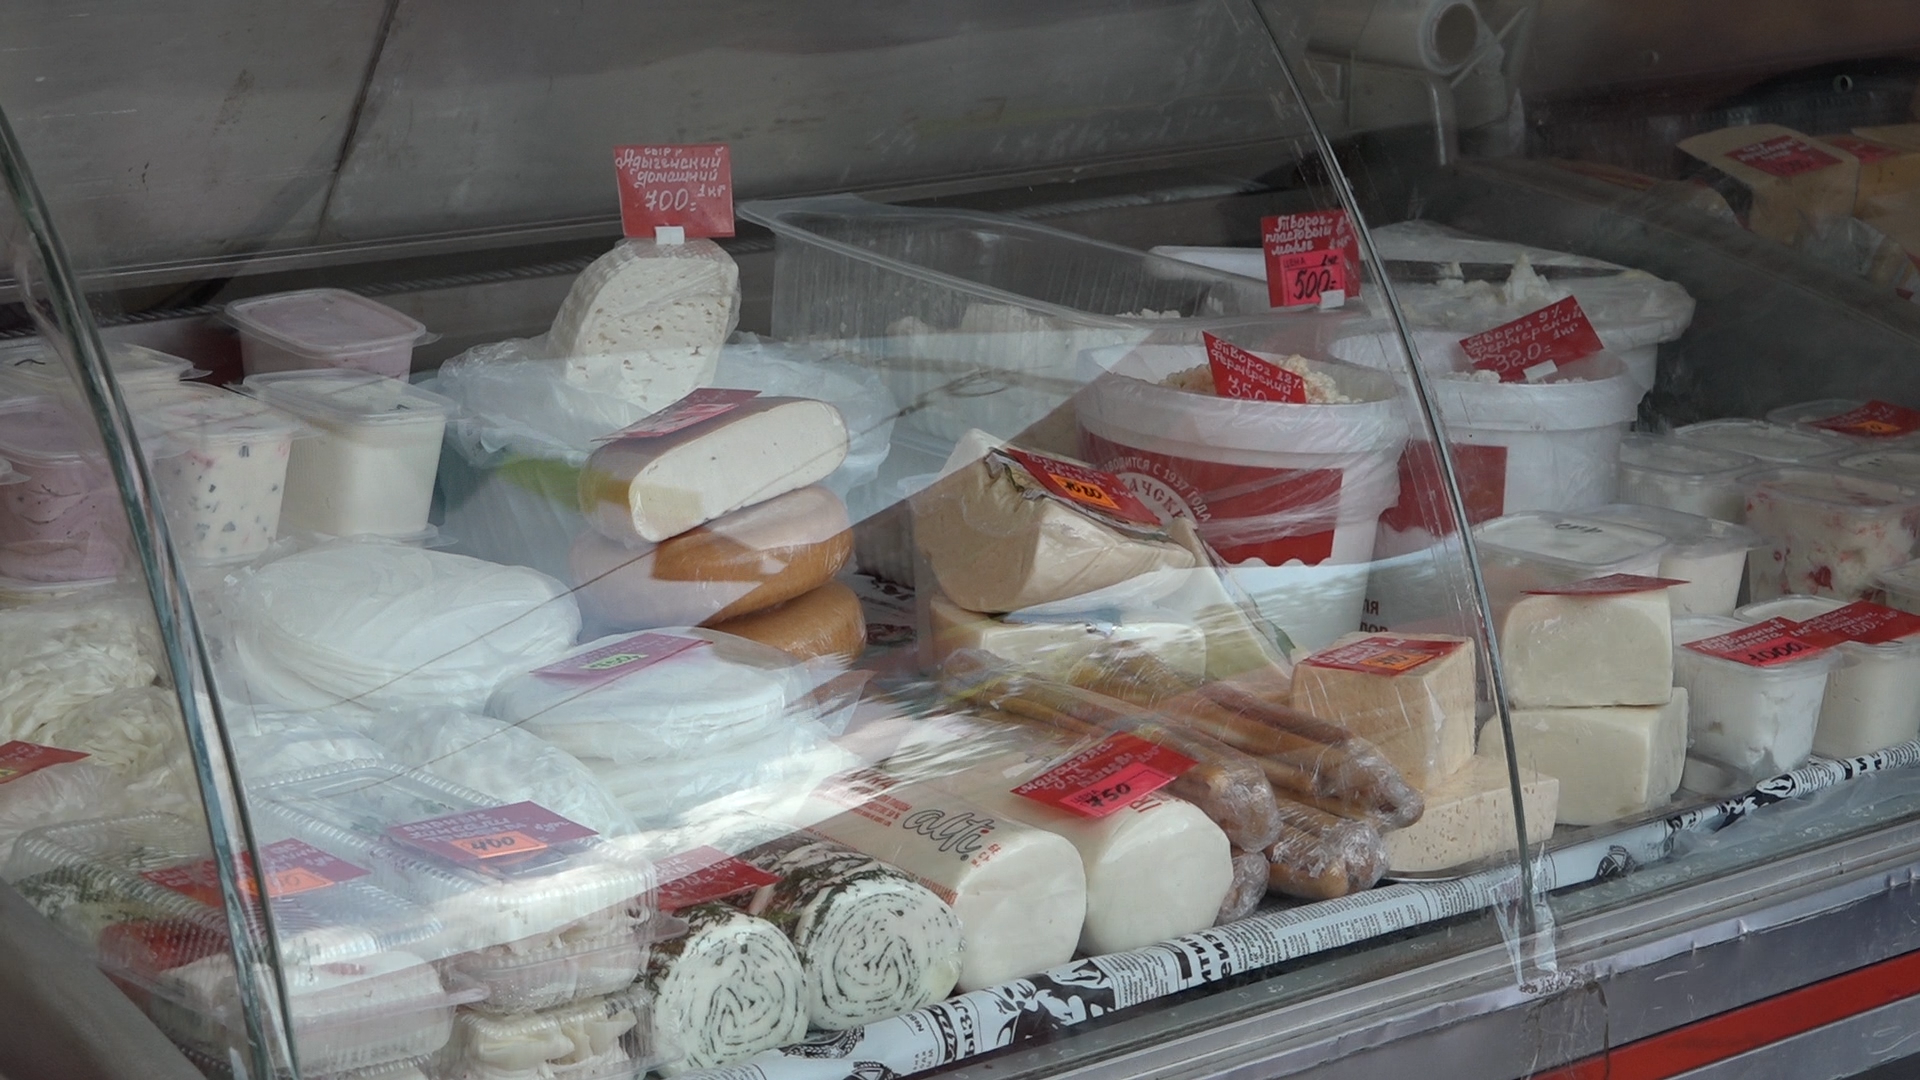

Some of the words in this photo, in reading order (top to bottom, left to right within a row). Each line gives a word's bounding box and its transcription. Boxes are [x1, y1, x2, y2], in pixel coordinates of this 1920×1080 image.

[1152, 463, 1160, 476] С
[1163, 469, 1190, 491] 1937
[1187, 487, 1212, 523] ГОДА
[471, 836, 516, 851] 400
